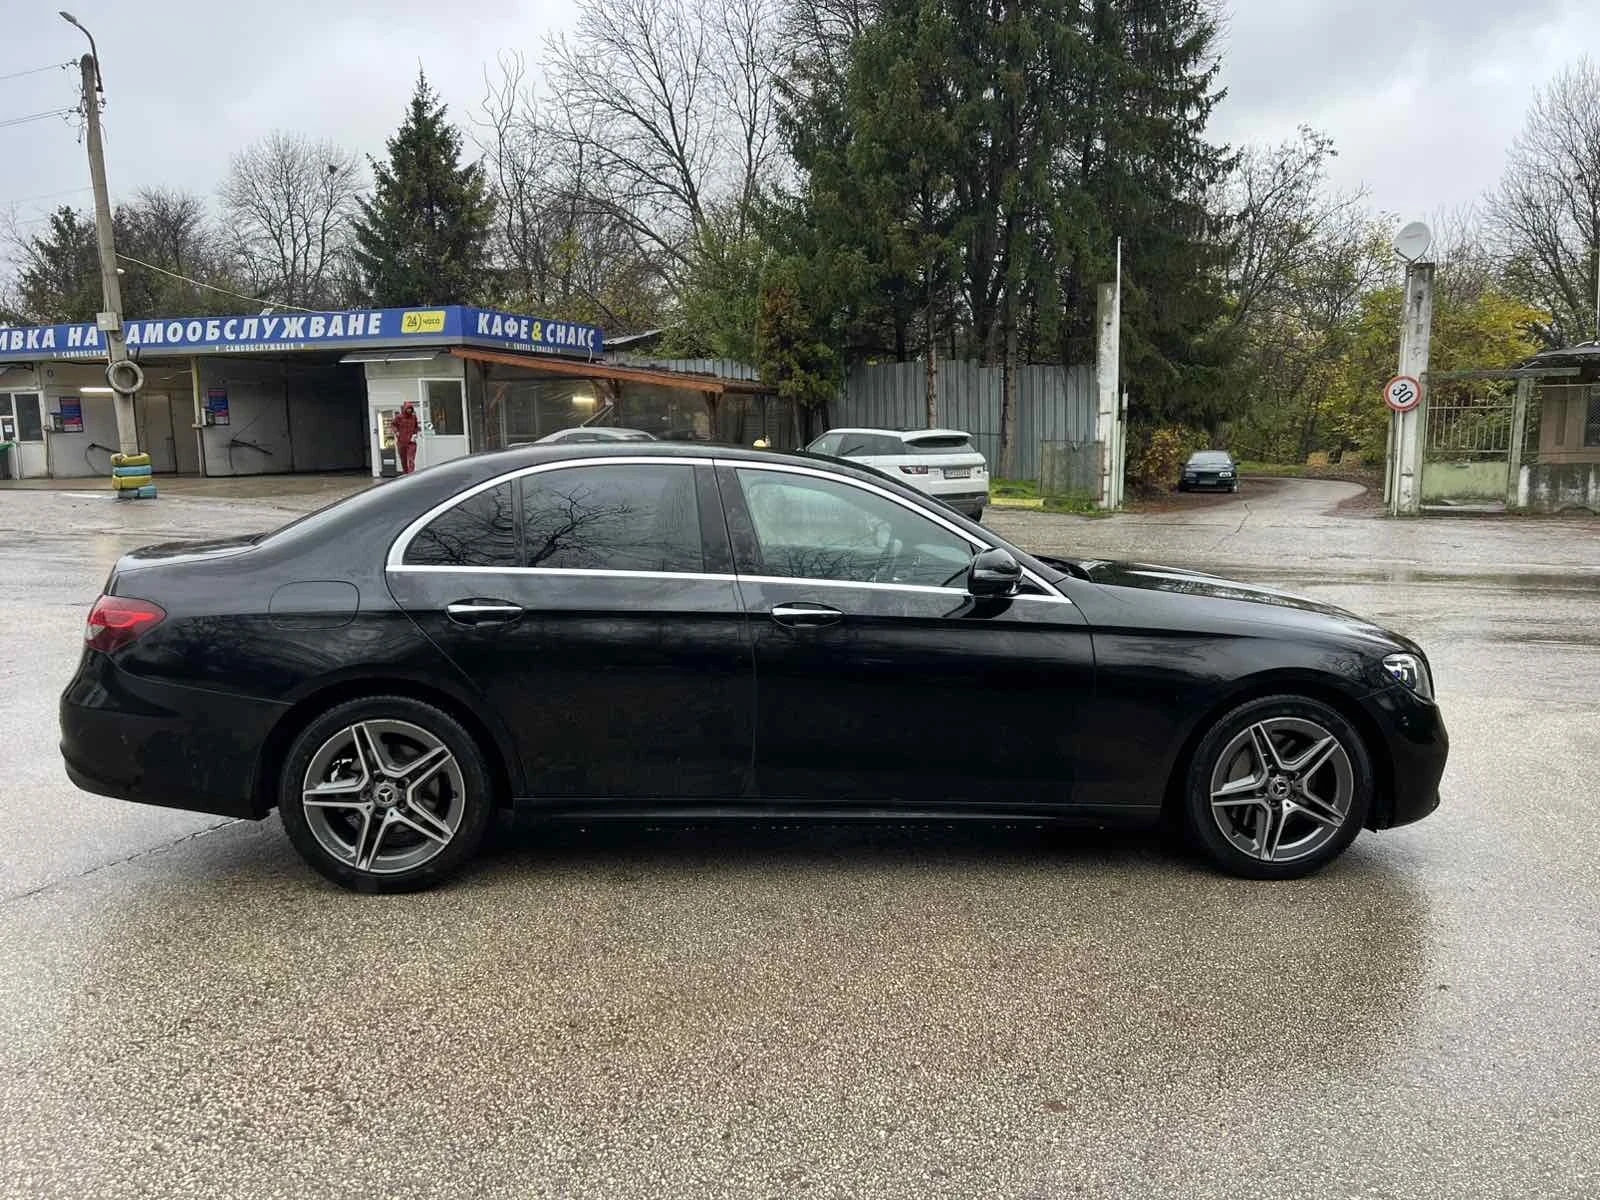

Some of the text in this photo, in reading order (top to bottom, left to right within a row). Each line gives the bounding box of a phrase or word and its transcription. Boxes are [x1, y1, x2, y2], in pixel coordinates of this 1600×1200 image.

[67, 326, 99, 347] НА
[125, 313, 383, 345] АМООБСЛУЖВАНЕ
[477, 312, 595, 348] КАФЕ & СНАКС
[1392, 383, 1414, 404] 30
